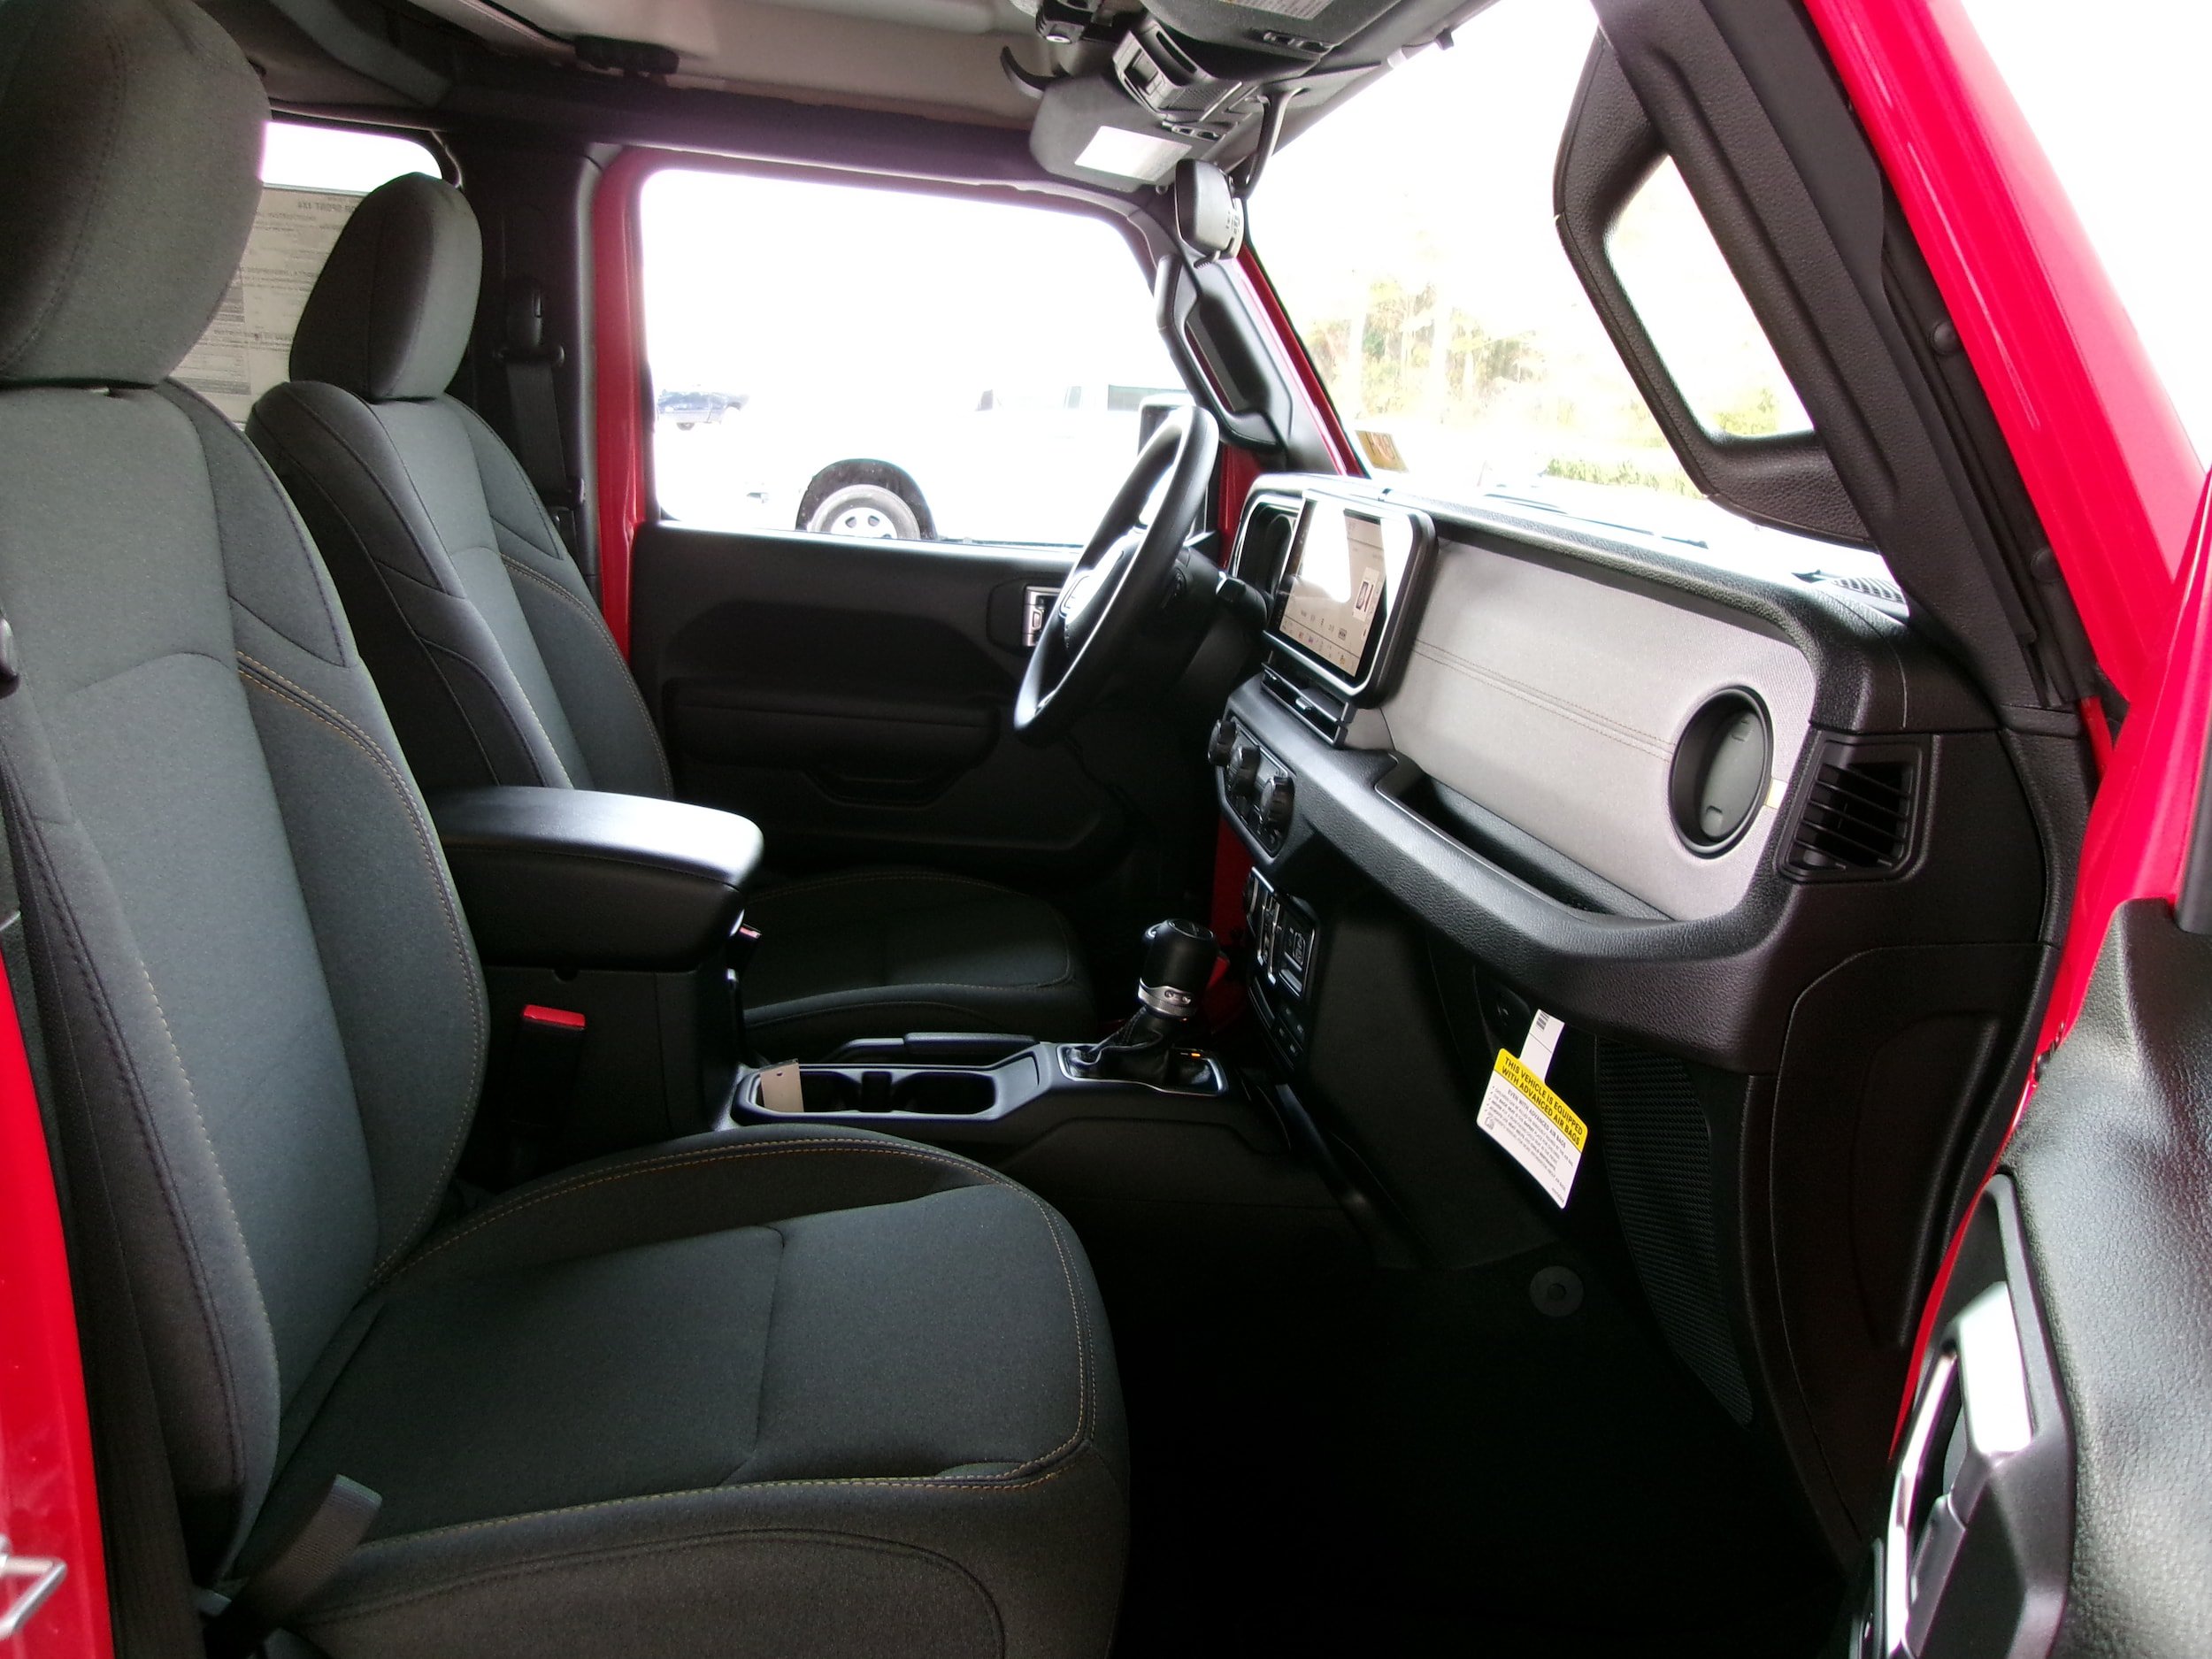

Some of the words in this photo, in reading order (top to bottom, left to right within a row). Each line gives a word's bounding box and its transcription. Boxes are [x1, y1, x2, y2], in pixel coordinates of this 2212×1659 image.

[1502, 1065, 1519, 1085] WITH
[1519, 1082, 1553, 1116] ADVANCED
[1553, 1114, 1563, 1129] AIR
[1564, 1125, 1579, 1146] BAGS
[1505, 1056, 1520, 1073] THIS
[1521, 1070, 1547, 1099] VEHICLE
[1547, 1094, 1553, 1105] IS
[1554, 1101, 1583, 1135] EQUIPPED
[1508, 1089, 1518, 1102] EVEN
[1519, 1098, 1529, 1111] WITH
[1529, 1109, 1549, 1131] ADVANCED
